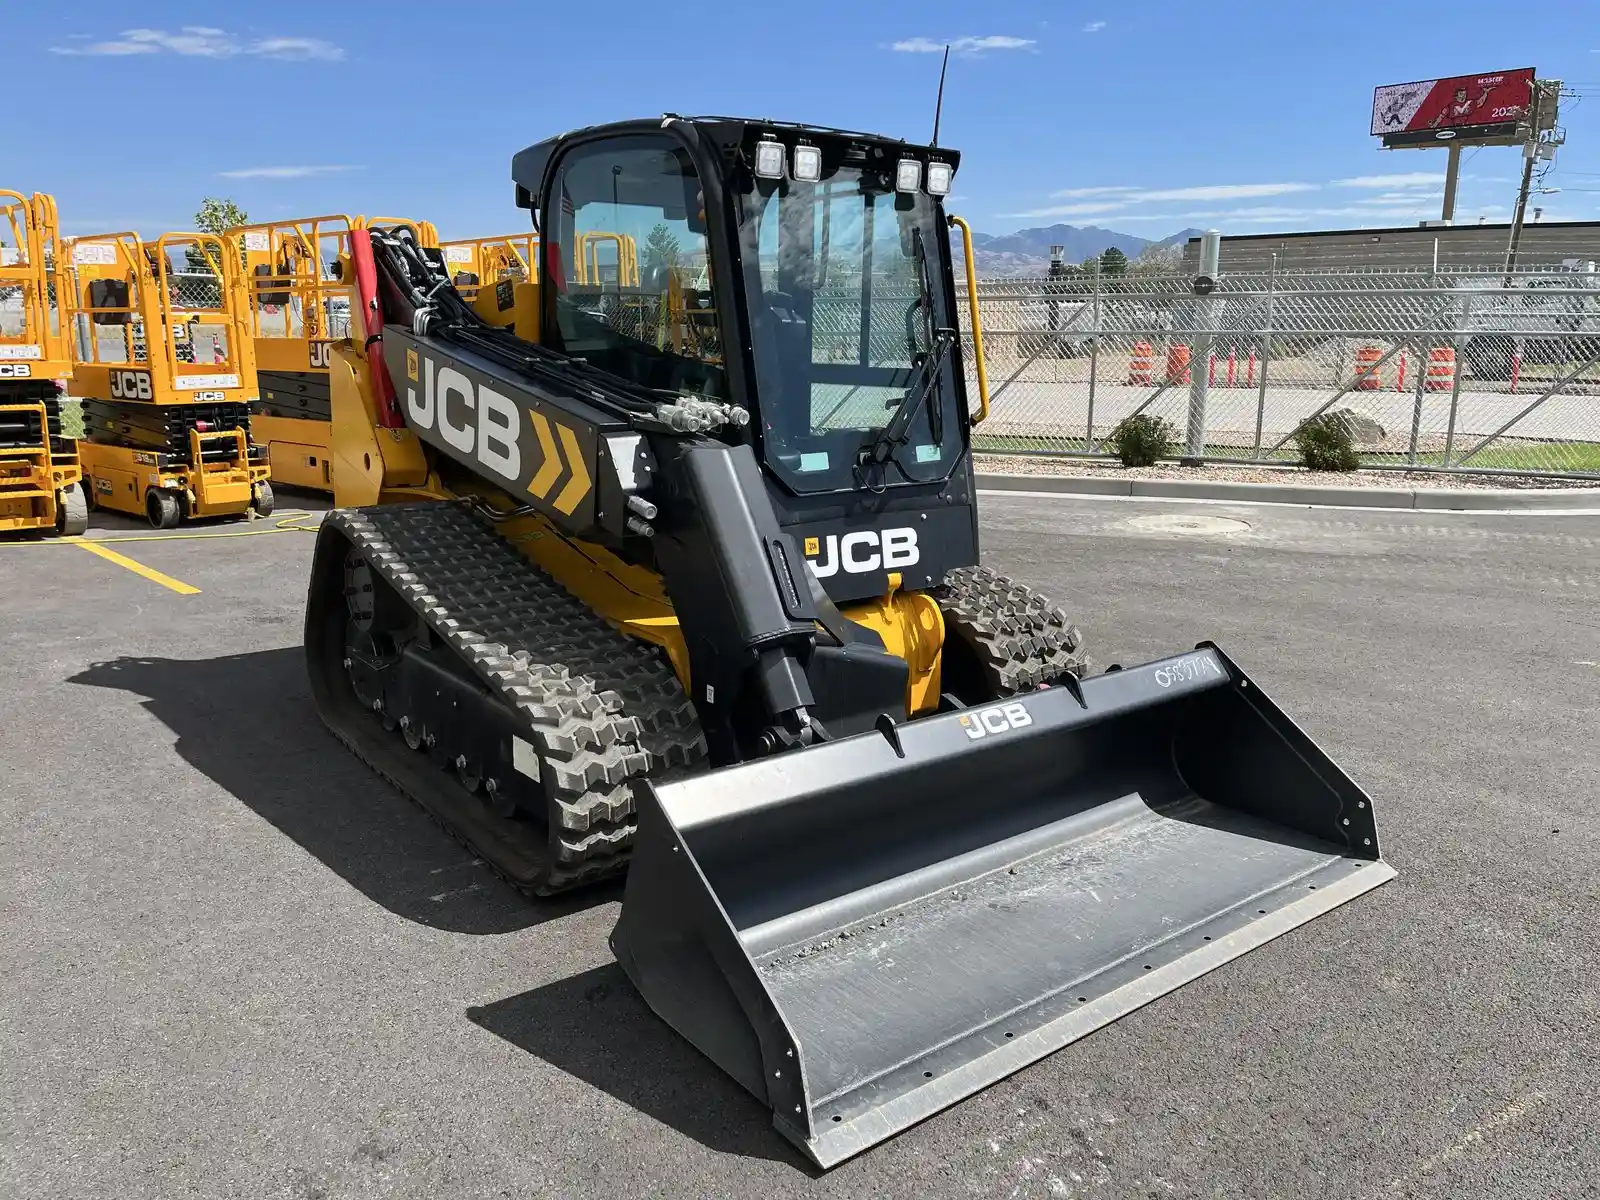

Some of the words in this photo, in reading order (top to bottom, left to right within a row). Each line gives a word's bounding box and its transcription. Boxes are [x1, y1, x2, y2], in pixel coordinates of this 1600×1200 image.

[111, 371, 152, 399] JCB
[194, 392, 225, 401] JCB
[408, 357, 520, 481] JCB
[806, 527, 920, 579] JCB
[965, 702, 1033, 739] JCB
